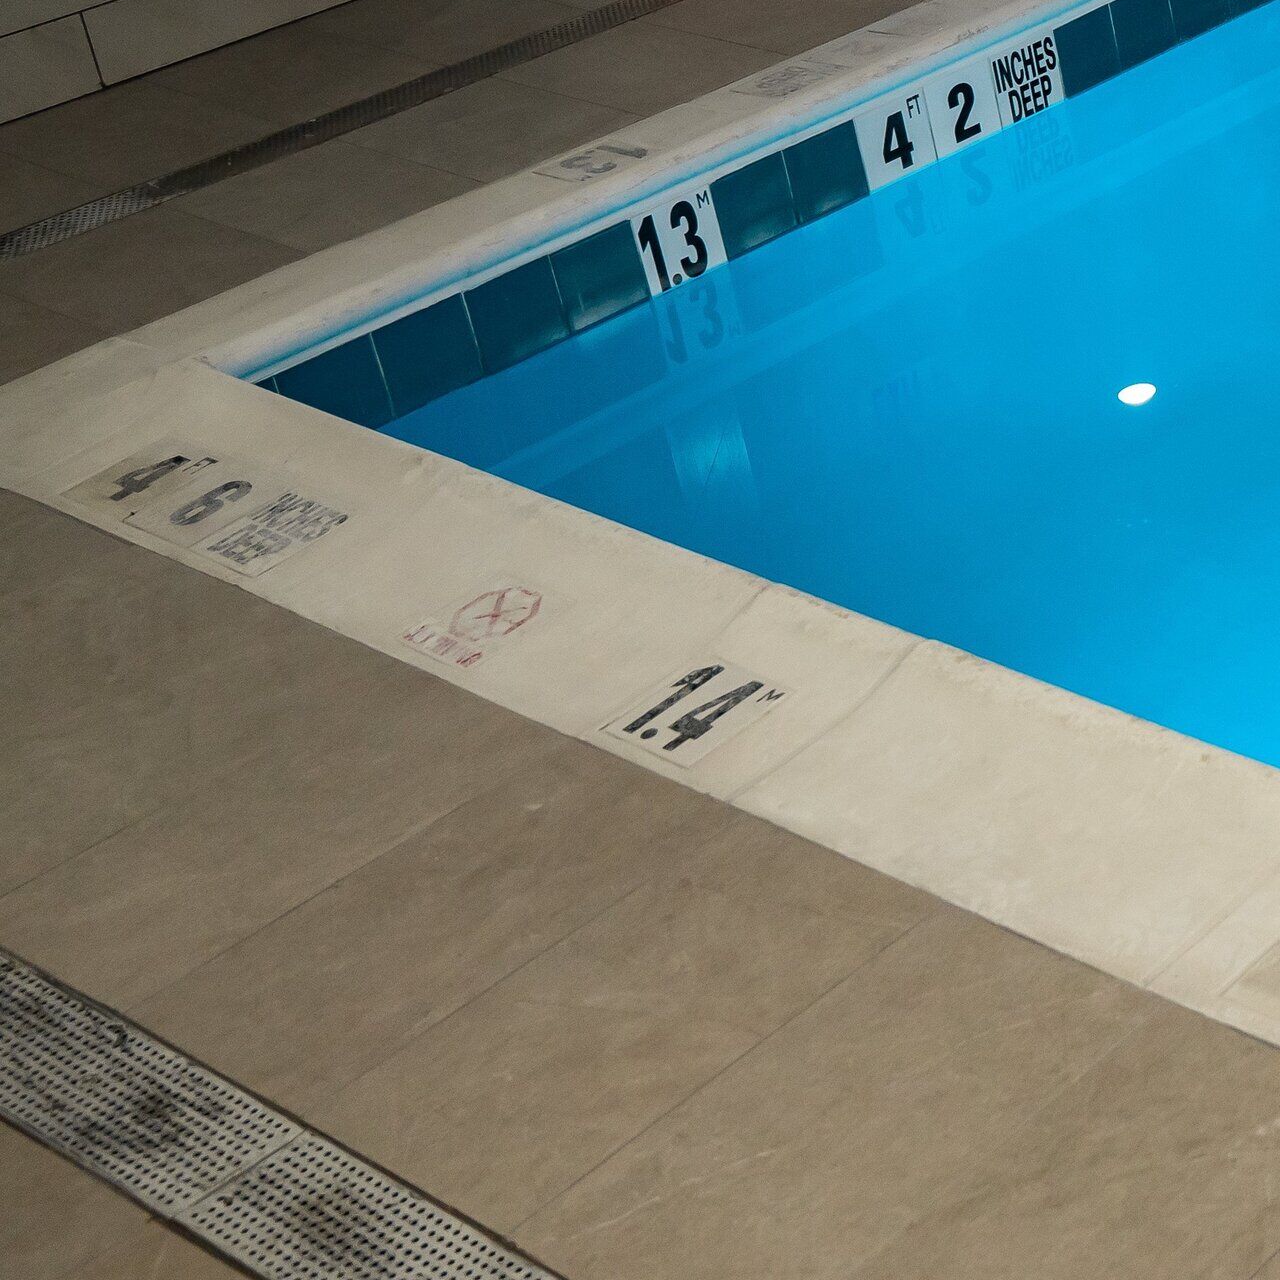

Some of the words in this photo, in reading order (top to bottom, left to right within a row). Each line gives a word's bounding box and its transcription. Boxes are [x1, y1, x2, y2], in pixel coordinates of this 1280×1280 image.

[992, 37, 1057, 94] INCHES
[883, 110, 914, 169] 4
[905, 94, 921, 119] FT
[947, 82, 982, 144] 2
[1007, 74, 1052, 124] DEEP
[637, 200, 708, 292] 1.3
[695, 190, 710, 208] M
[106, 455, 191, 501] 4
[169, 480, 252, 526] 6
[623, 664, 764, 751] 1.4
